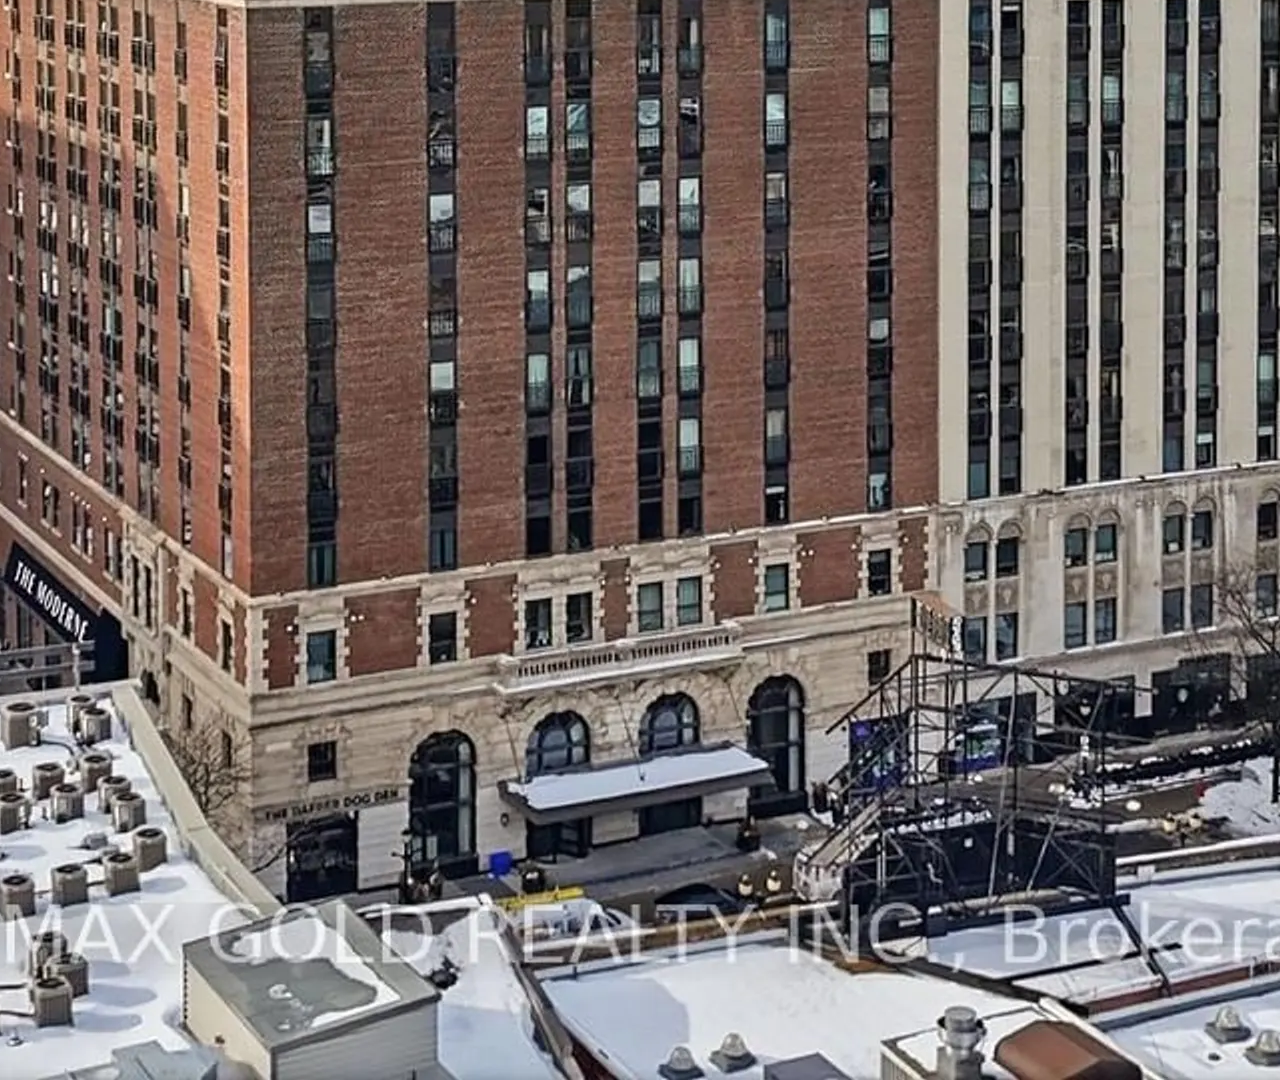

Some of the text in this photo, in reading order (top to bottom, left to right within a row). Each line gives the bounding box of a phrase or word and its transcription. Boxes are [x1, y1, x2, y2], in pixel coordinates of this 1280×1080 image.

[14, 561, 89, 643] THE MODERNE
[343, 793, 371, 808] DOG
